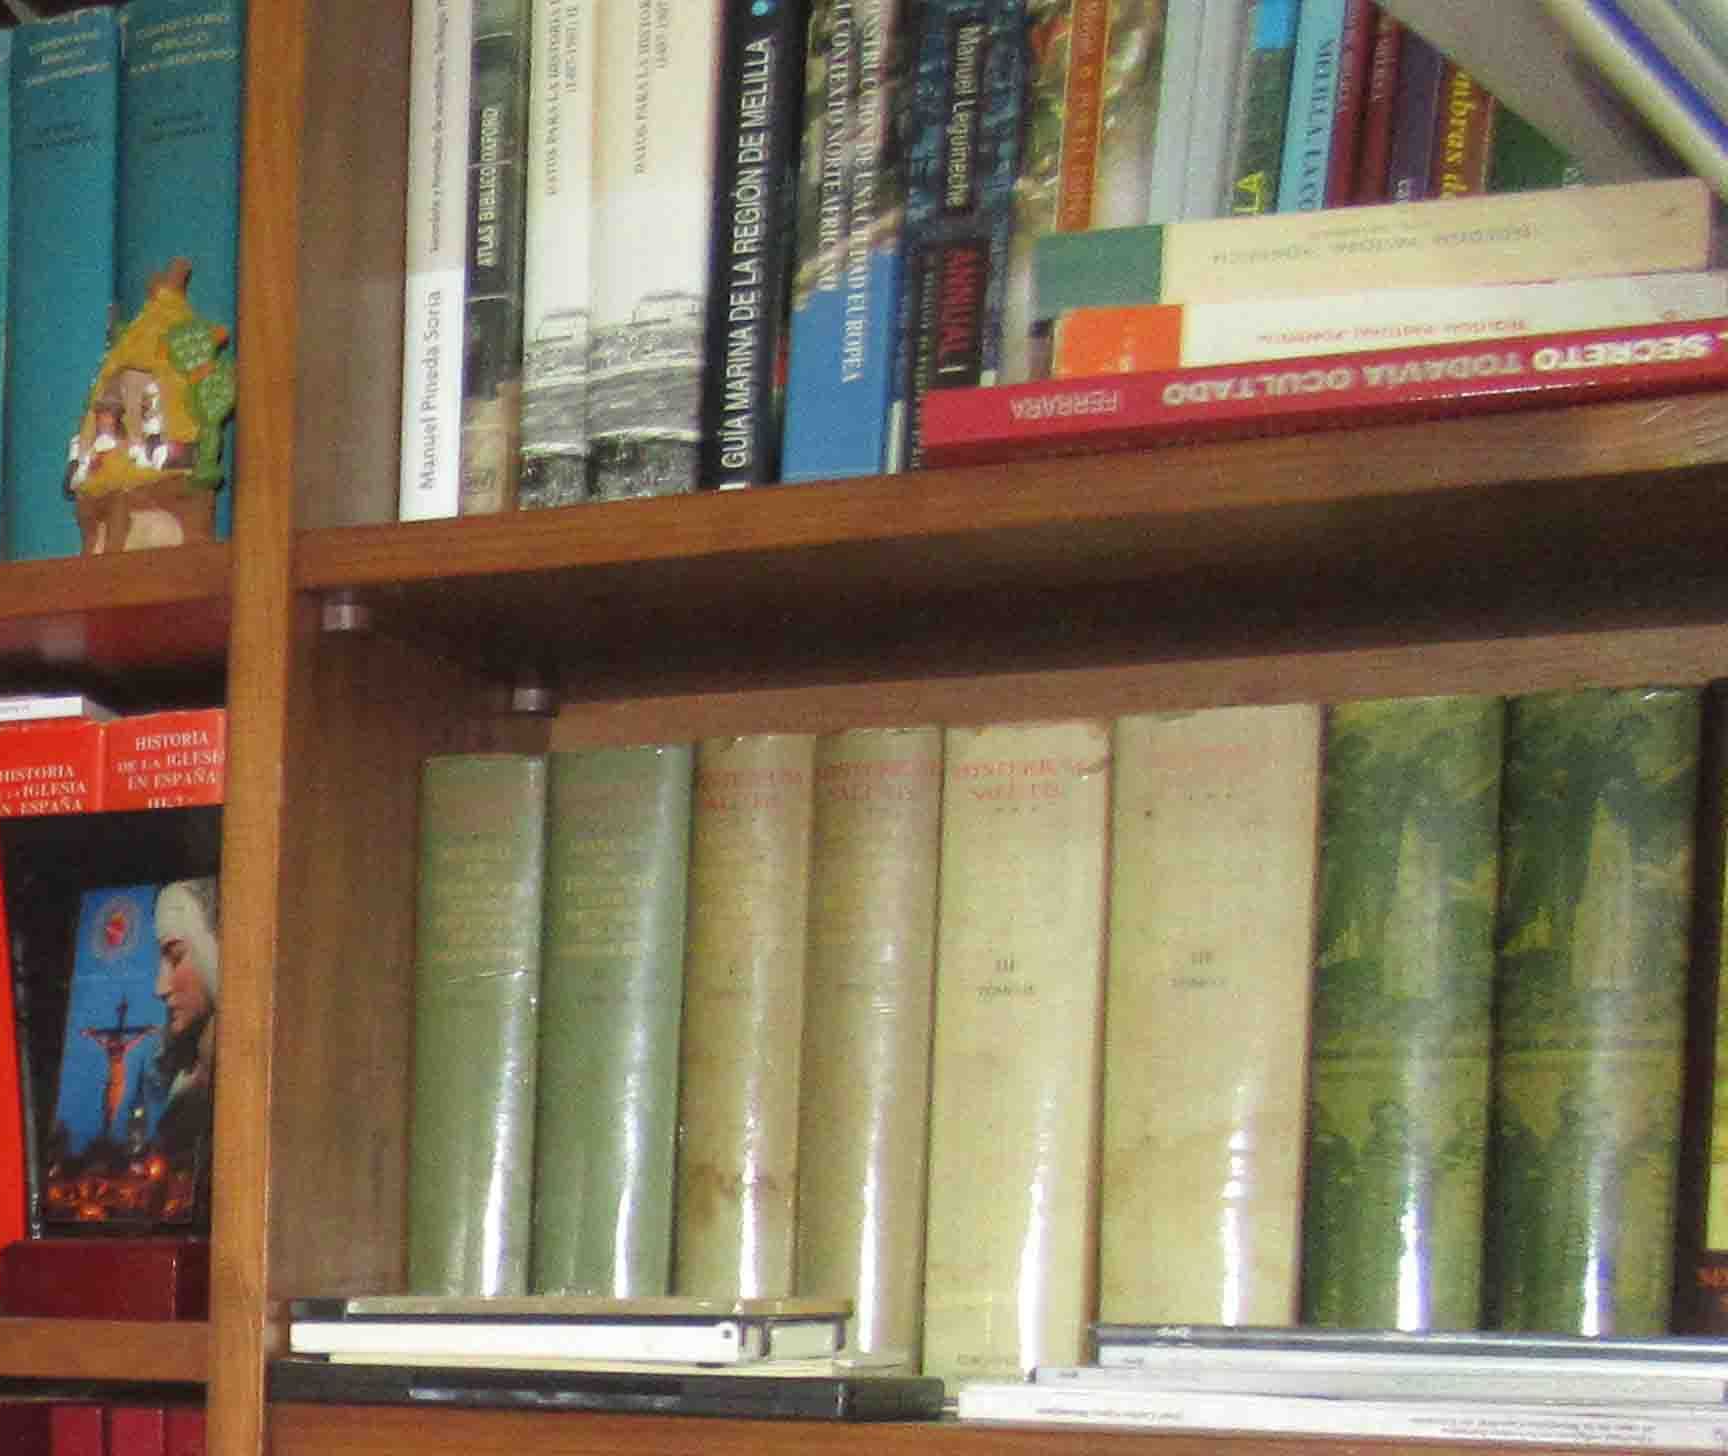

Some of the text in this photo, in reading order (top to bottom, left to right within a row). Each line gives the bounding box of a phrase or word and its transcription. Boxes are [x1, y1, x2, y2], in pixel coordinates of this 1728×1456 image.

[480, 106, 499, 164] OXFORD
[944, 25, 981, 207] Manuel Leguineche
[477, 225, 496, 268] ATLAS
[719, 37, 771, 469] GUÍA MARINA DE LA REGIÓN DE MELILLA
[840, 214, 871, 384] CIUDAD EUROPEA
[1534, 332, 1715, 372] SECRETO
[418, 290, 442, 490] Manuel Pineda Soria
[1009, 389, 1119, 421] FERRARA
[1160, 365, 1352, 407] OCULTADO
[134, 730, 211, 753] HISTORIA
[23, 778, 89, 801] IGLESIA
[127, 766, 219, 792] EN ESPAÑA
[18, 794, 85, 816] ESPAÑA
